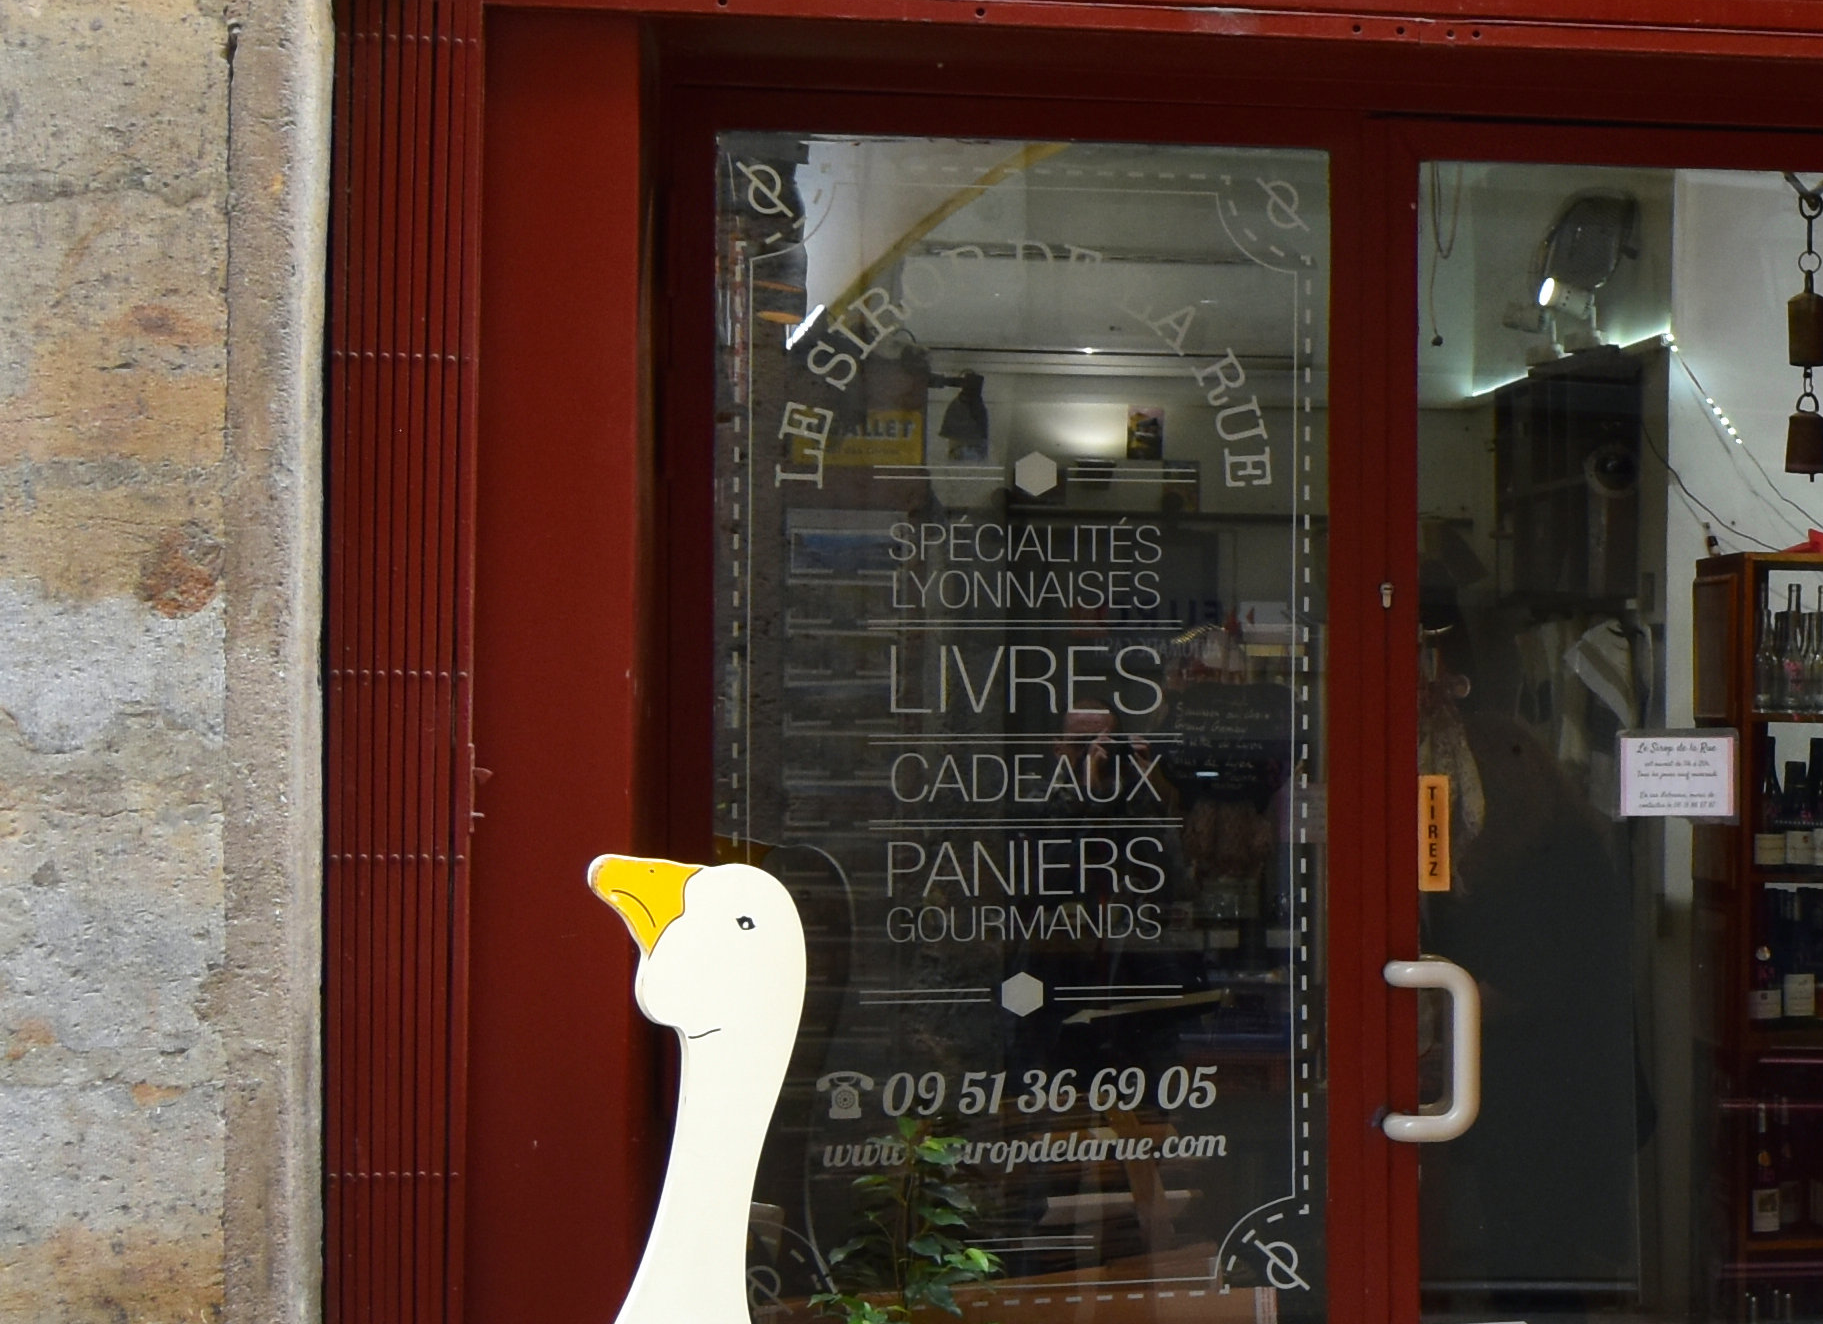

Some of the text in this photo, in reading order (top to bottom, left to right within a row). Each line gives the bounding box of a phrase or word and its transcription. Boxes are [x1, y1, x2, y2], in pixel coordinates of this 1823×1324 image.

[775, 400, 834, 490] LE
[1192, 347, 1272, 487] RUE
[888, 514, 1162, 563] SPÉCIALITÉS
[893, 570, 1160, 609] LYONNAISES
[890, 645, 1163, 715] LIVRES
[890, 751, 1163, 804] CADEAUX
[1427, 785, 1438, 877] TIREZ
[887, 836, 1166, 898] PANIERS
[887, 902, 1162, 944] GOURMANDS
[882, 1065, 1218, 1117] 09 51 36 69 05
